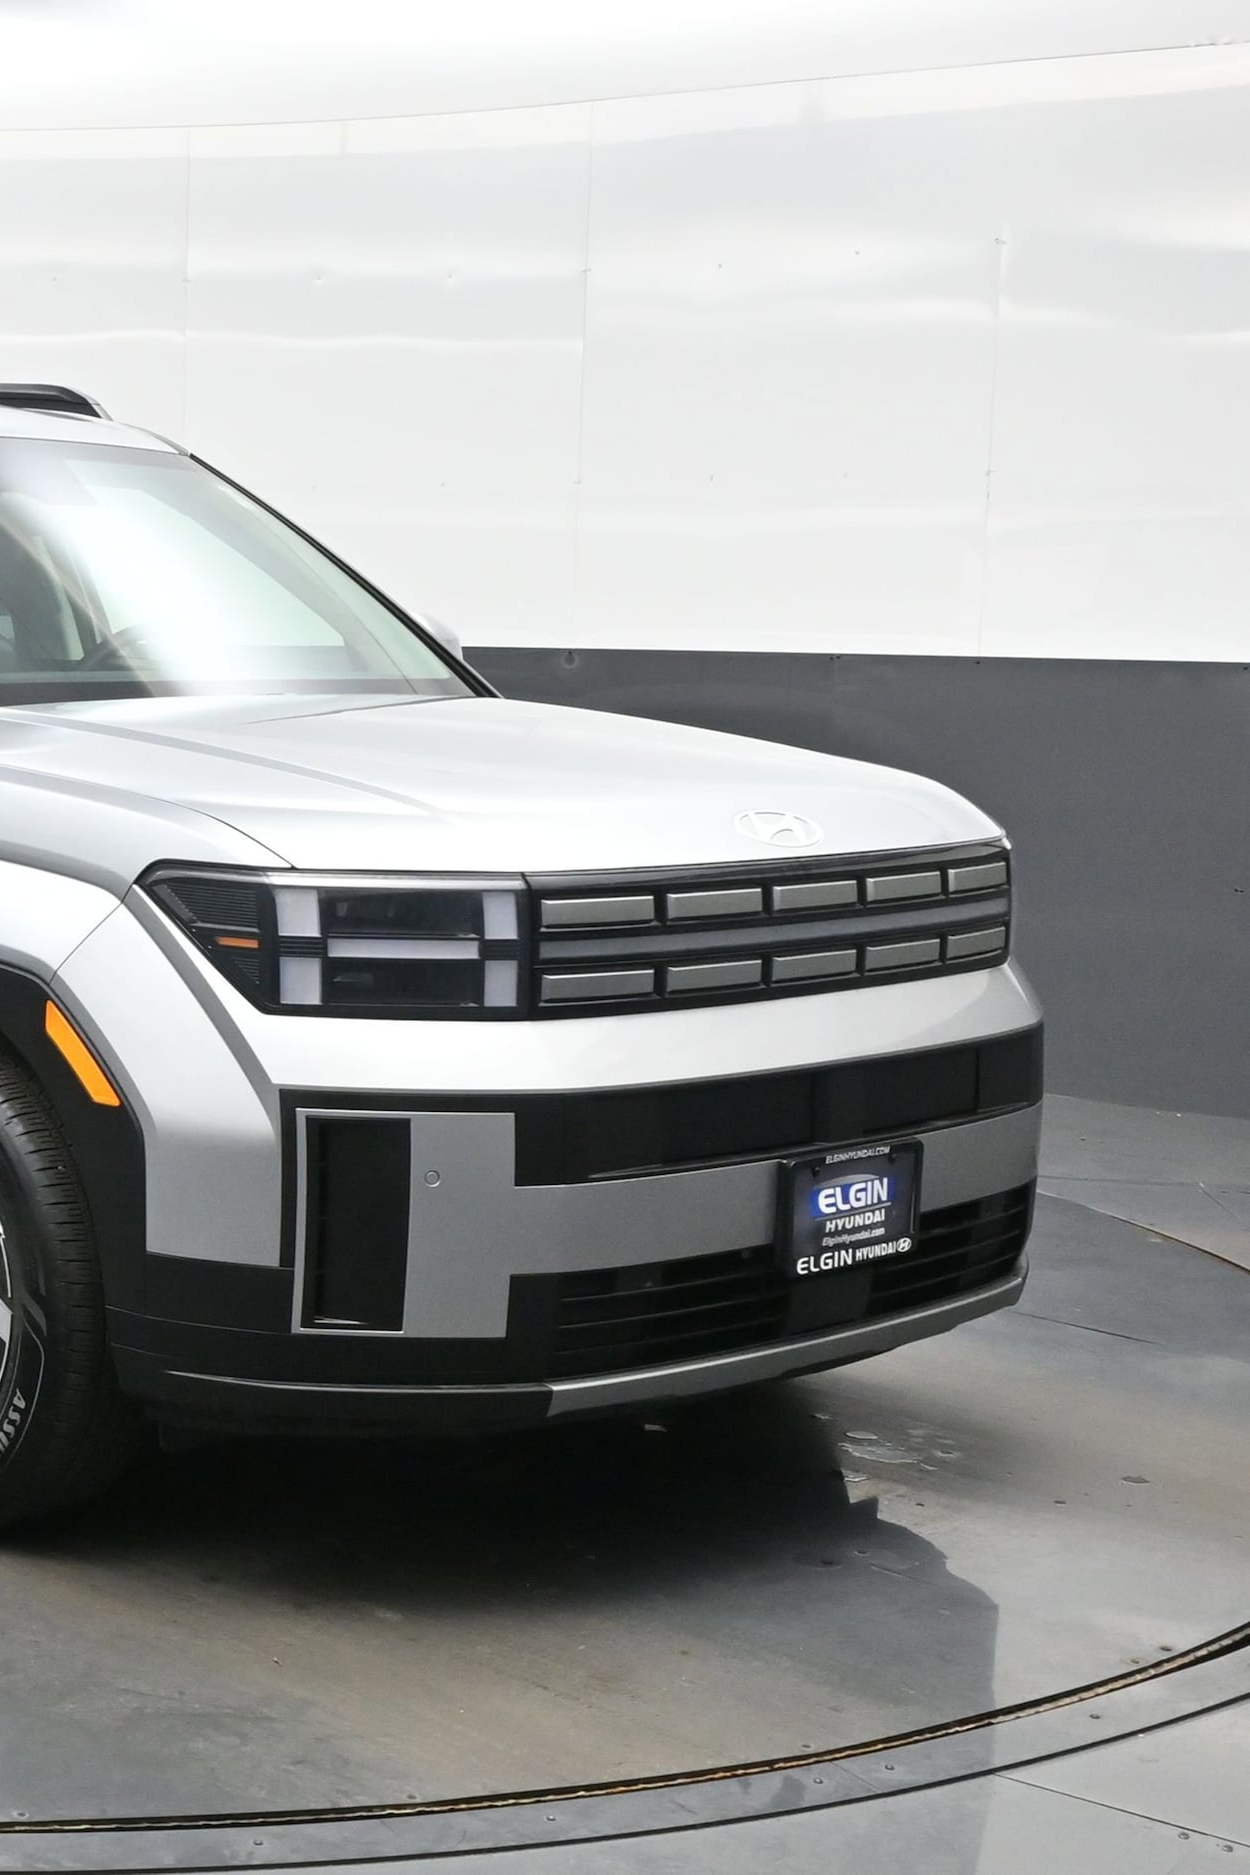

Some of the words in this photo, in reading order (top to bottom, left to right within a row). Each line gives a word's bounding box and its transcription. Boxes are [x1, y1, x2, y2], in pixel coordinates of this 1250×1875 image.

[825, 1146, 891, 1164] ELGINHYUNDAI.COM
[818, 1177, 888, 1214] ELGIN
[825, 1208, 885, 1233] HYUNDAI
[796, 1248, 853, 1275] ELGIN
[855, 1241, 896, 1261] HYUNDAI
